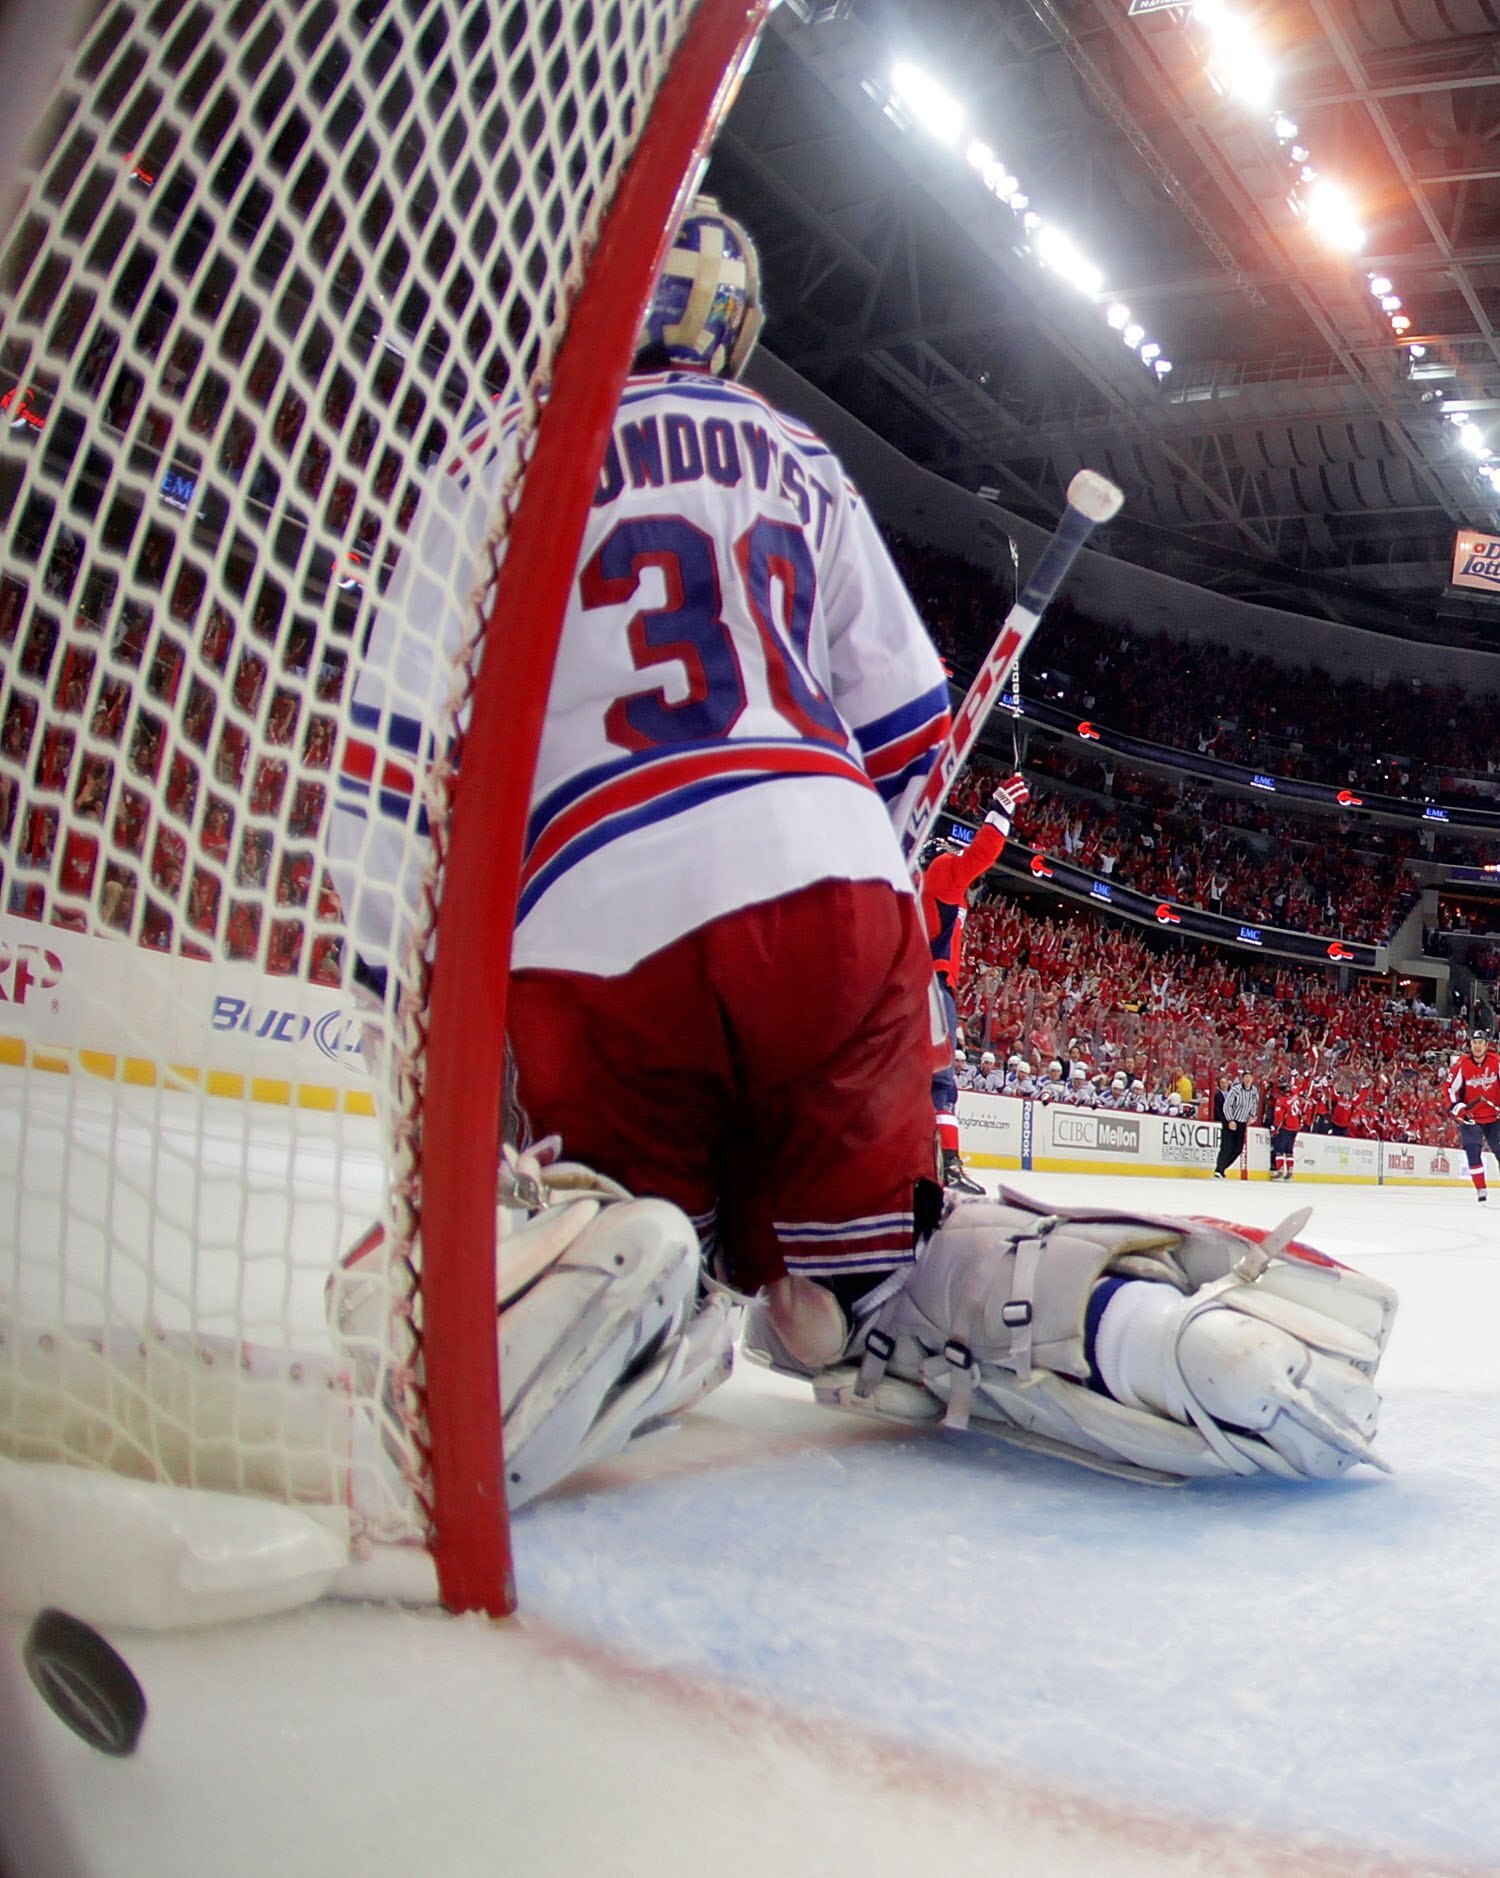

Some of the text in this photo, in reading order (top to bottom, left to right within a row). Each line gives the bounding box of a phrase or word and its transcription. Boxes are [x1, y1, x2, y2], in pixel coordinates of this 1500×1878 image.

[593, 412, 832, 552] UNDQVIST
[580, 513, 850, 757] 30
[1254, 775, 1275, 787] EMC
[1426, 807, 1448, 818] EMC
[951, 824, 975, 842] EMC
[1093, 881, 1111, 895] EMC
[1240, 927, 1261, 940] EMC
[211, 995, 312, 1043] BUD
[1023, 1101, 1031, 1158] Reebok
[1058, 1120, 1094, 1143] CIBC
[1099, 1124, 1137, 1148] Mellon
[1162, 1146, 1200, 1160] MAGNETIC
